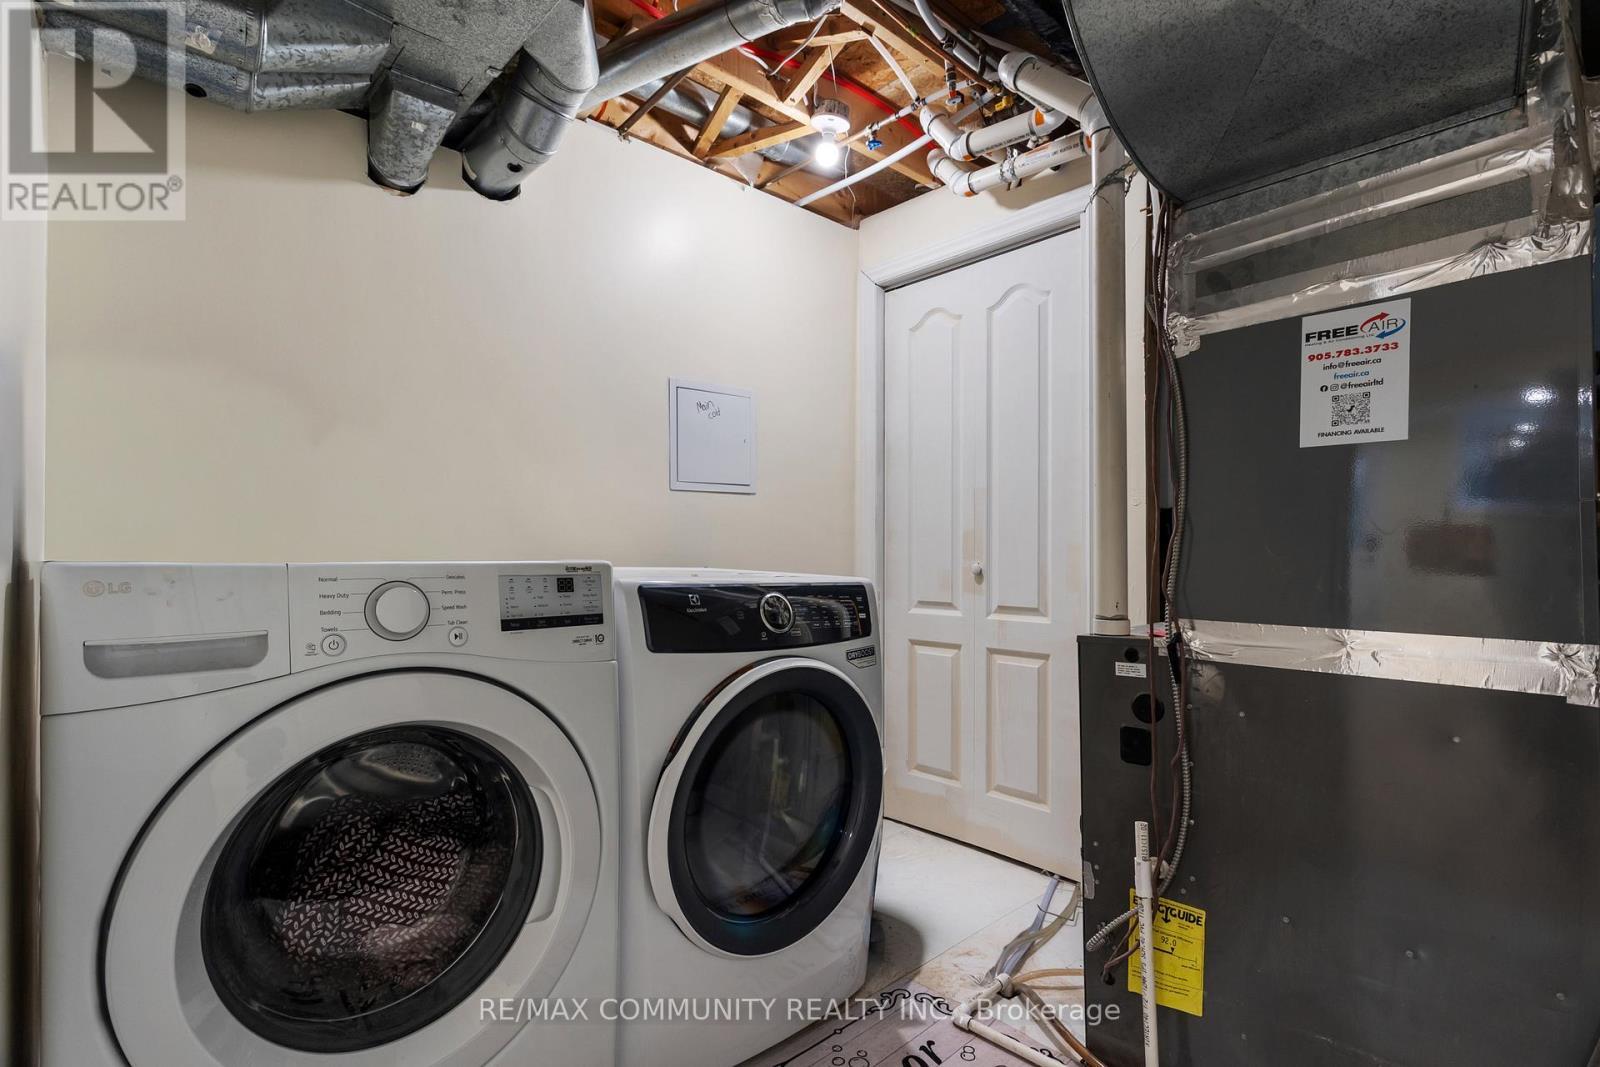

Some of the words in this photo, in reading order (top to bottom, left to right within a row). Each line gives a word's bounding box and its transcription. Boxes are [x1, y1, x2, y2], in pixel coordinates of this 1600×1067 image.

[1305, 325, 1359, 343] FREE
[1368, 318, 1399, 333] AIR
[1308, 342, 1399, 362] 905.783.3733
[1323, 357, 1382, 371] info@freeair.ca
[1333, 370, 1370, 380] freeair.ca
[1340, 377, 1384, 390] @freeairltd
[1317, 429, 1353, 438] FINANCING
[1353, 427, 1385, 435] AVAILABLE
[107, 582, 133, 594] LG
[319, 609, 342, 617] Bedding
[1160, 935, 1177, 947] 92.0
